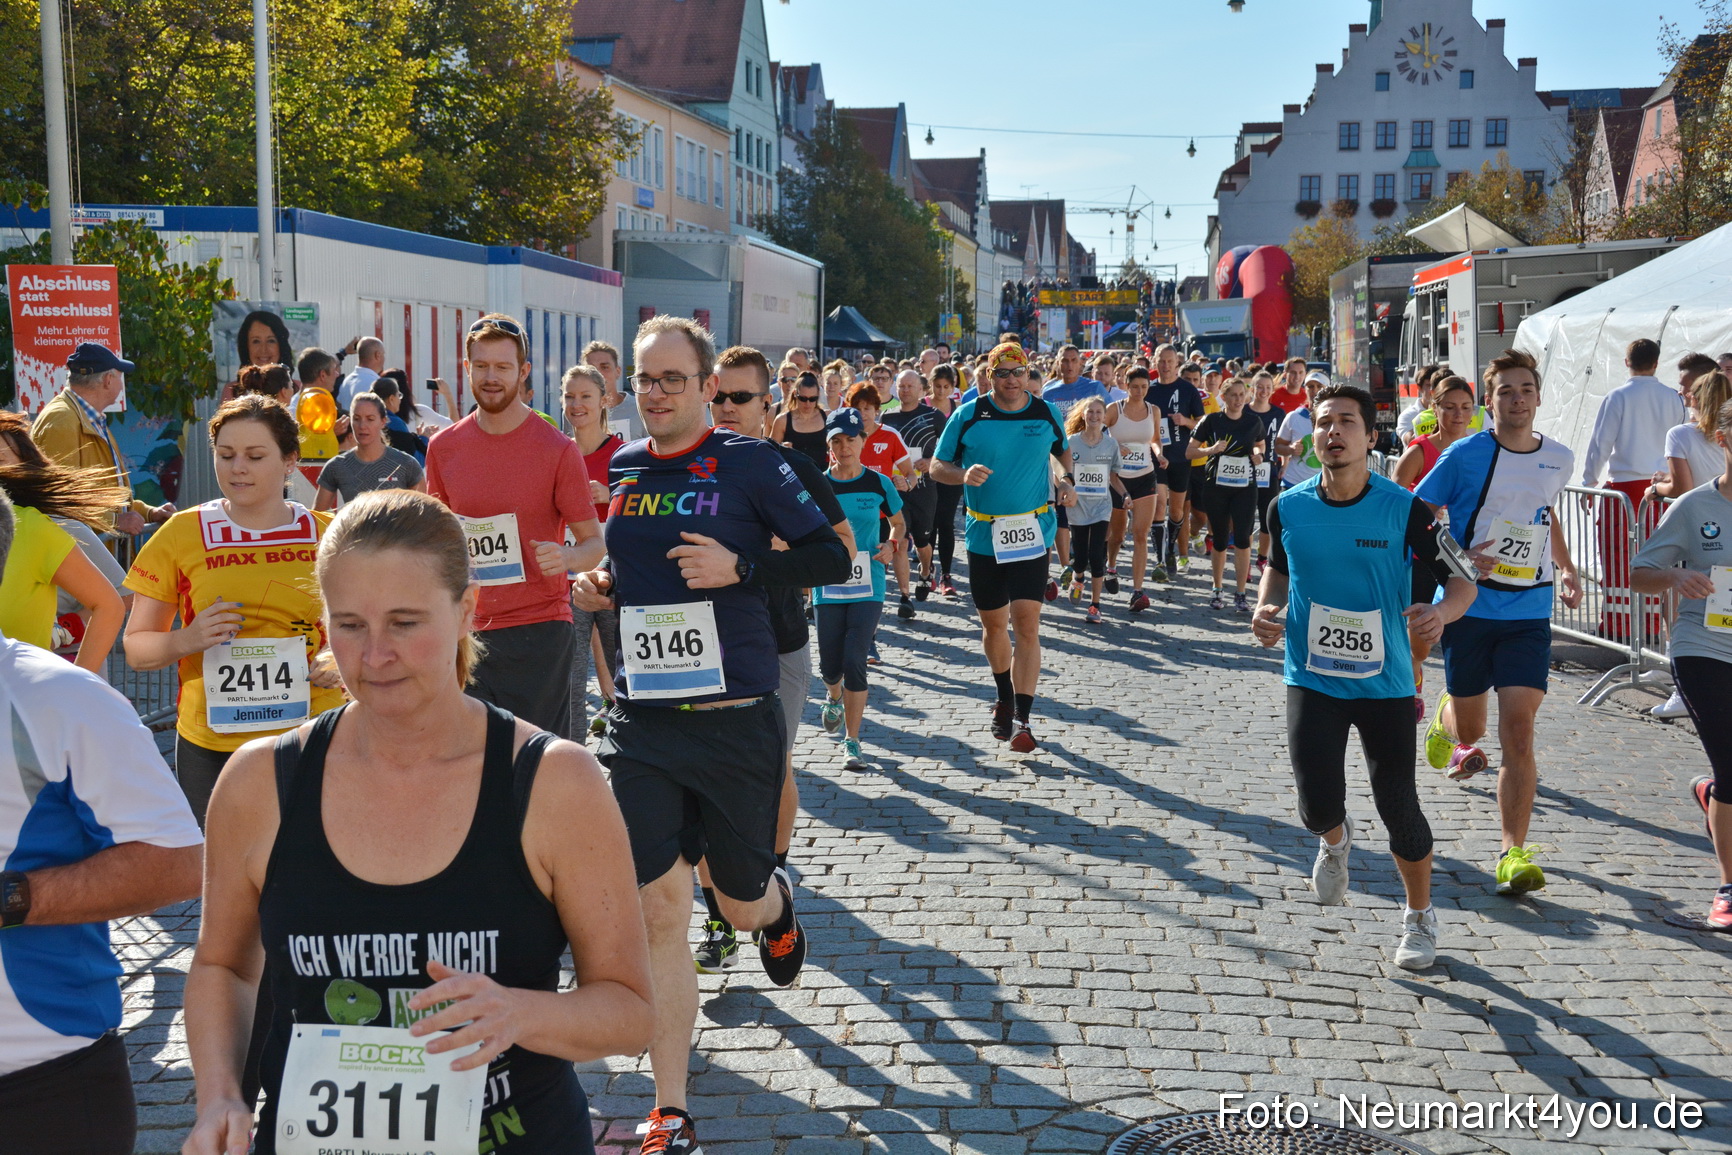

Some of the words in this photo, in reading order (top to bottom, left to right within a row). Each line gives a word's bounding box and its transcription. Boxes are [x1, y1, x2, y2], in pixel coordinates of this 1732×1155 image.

[18, 275, 111, 291] Abschluss
[19, 291, 50, 302] statt
[1071, 293, 1105, 302] START
[20, 303, 113, 317] Ausschluss!
[37, 325, 63, 335] Mehr
[66, 325, 94, 335] Lehrer
[96, 325, 110, 335] für
[34, 336, 72, 346] kleinere
[1222, 464, 1246, 474] 2554
[1079, 472, 1104, 483] 2068
[609, 491, 720, 517] MENSCH
[1000, 527, 1036, 545] 3035
[1355, 538, 1388, 549] THULE
[1498, 537, 1532, 559] 275
[205, 552, 258, 570] MAX
[1498, 566, 1520, 576] Lukas
[646, 612, 686, 624] BOCK
[1330, 614, 1364, 627] BOCK
[634, 628, 704, 660] 3146
[1318, 626, 1373, 652] 2358
[232, 646, 276, 656] BOCK
[1332, 660, 1356, 671] Sven
[218, 661, 293, 692] 2414
[249, 694, 280, 702] Neumarkt
[233, 707, 284, 721] Jennifer
[288, 934, 332, 977] ICH
[333, 933, 420, 978] WERDE
[427, 930, 499, 974] NICHT
[340, 1042, 426, 1066] BOCK
[338, 1064, 362, 1072] inspired
[364, 1064, 372, 1072] by
[395, 1066, 426, 1074] concepts
[306, 1079, 440, 1142] 3111
[288, 1124, 294, 1135] D
